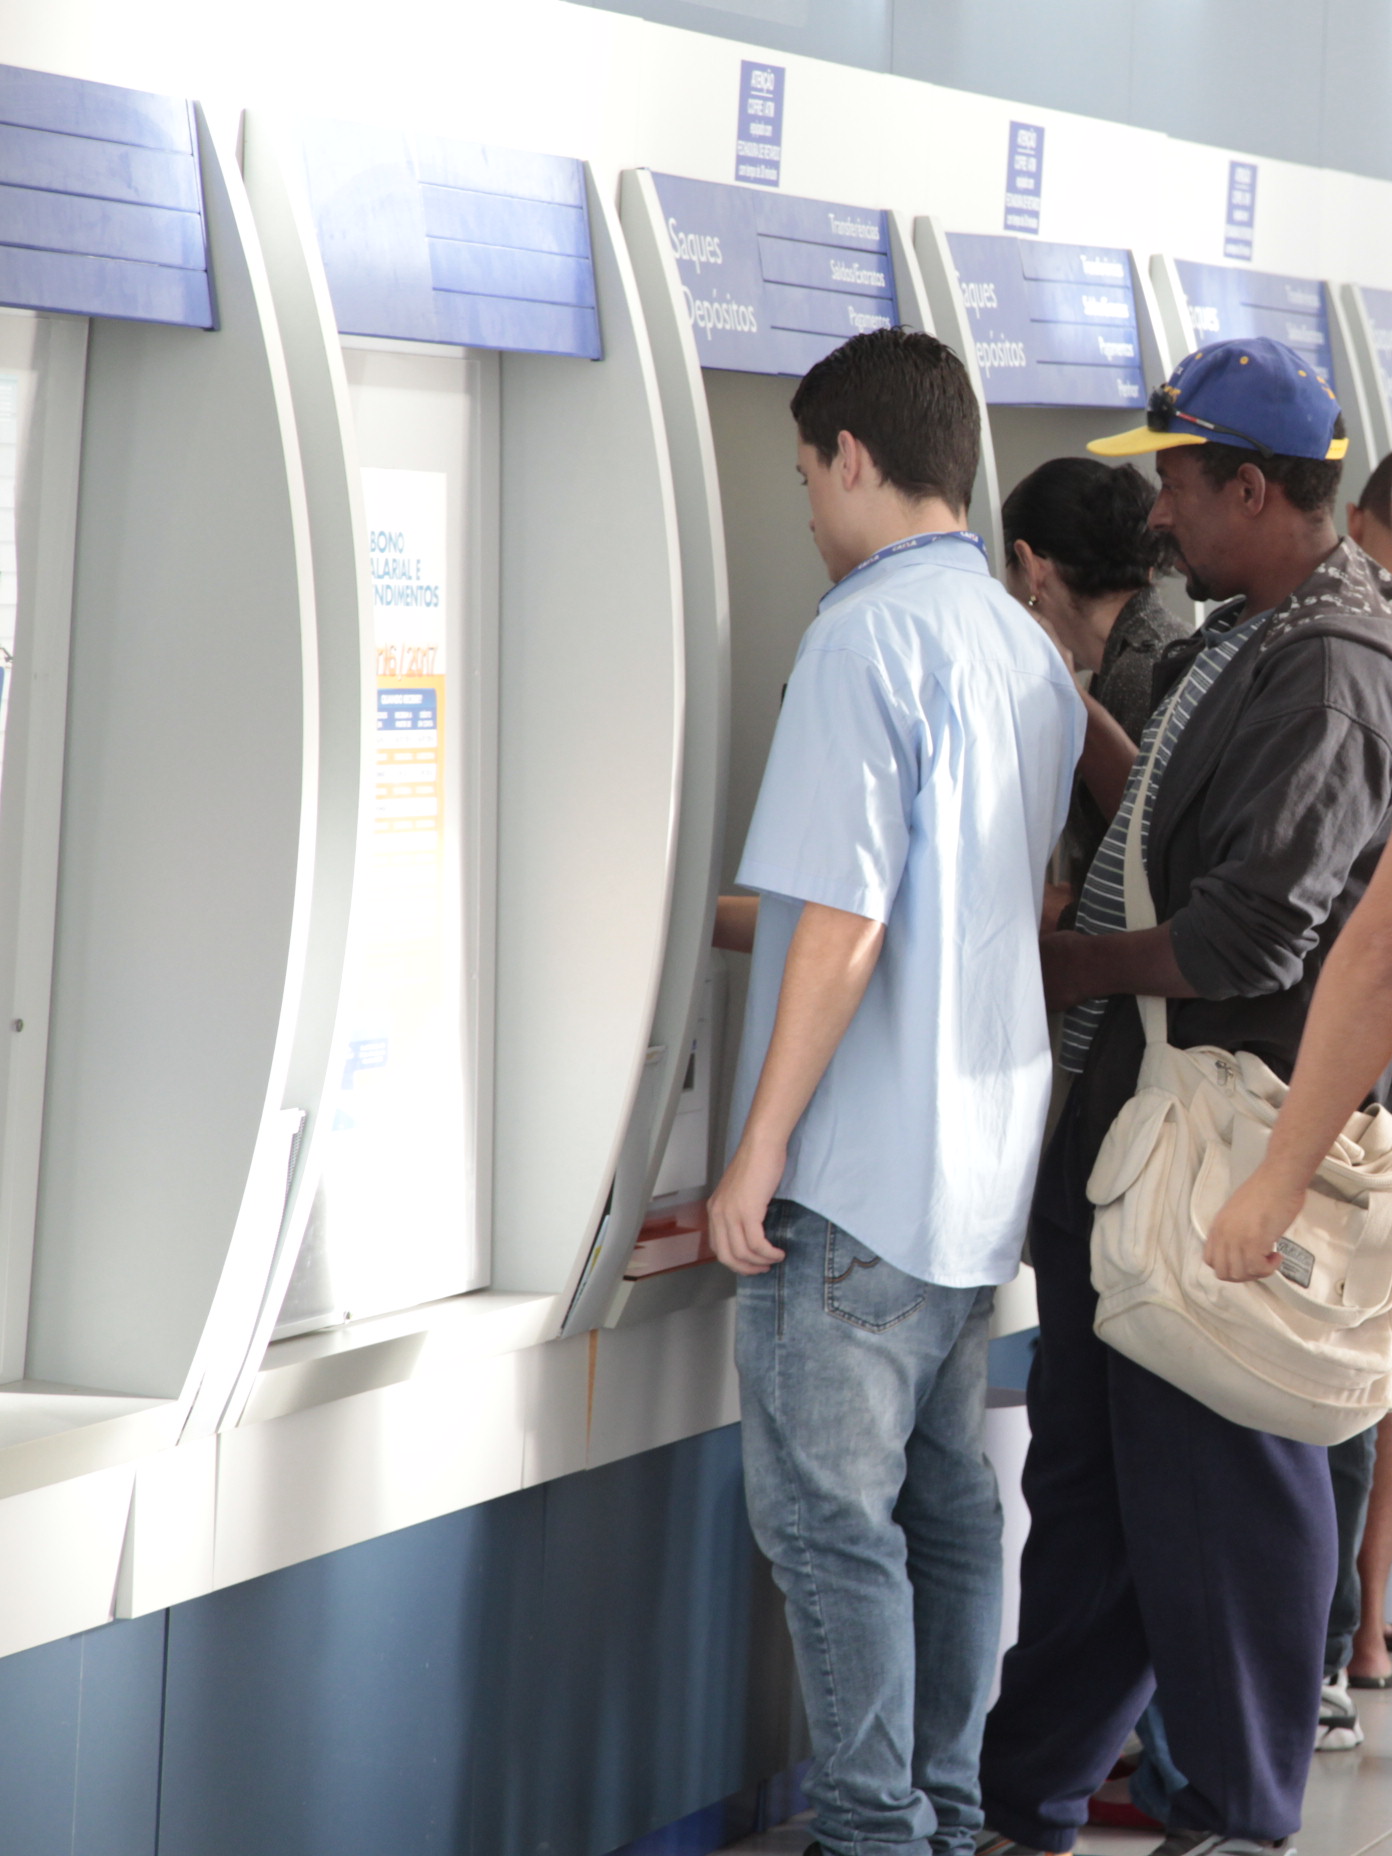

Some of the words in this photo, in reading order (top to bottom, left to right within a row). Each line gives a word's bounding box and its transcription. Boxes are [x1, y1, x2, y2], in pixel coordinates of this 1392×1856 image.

[668, 217, 723, 274] Saques
[682, 285, 758, 341] Depósitos
[959, 279, 998, 319] aques
[975, 330, 1026, 378] epósitos
[370, 530, 405, 554] BONO
[892, 540, 918, 552] CAIXA
[370, 557, 412, 581] ALARIAL
[416, 558, 421, 581] E
[374, 584, 439, 607] NDIMENTOS
